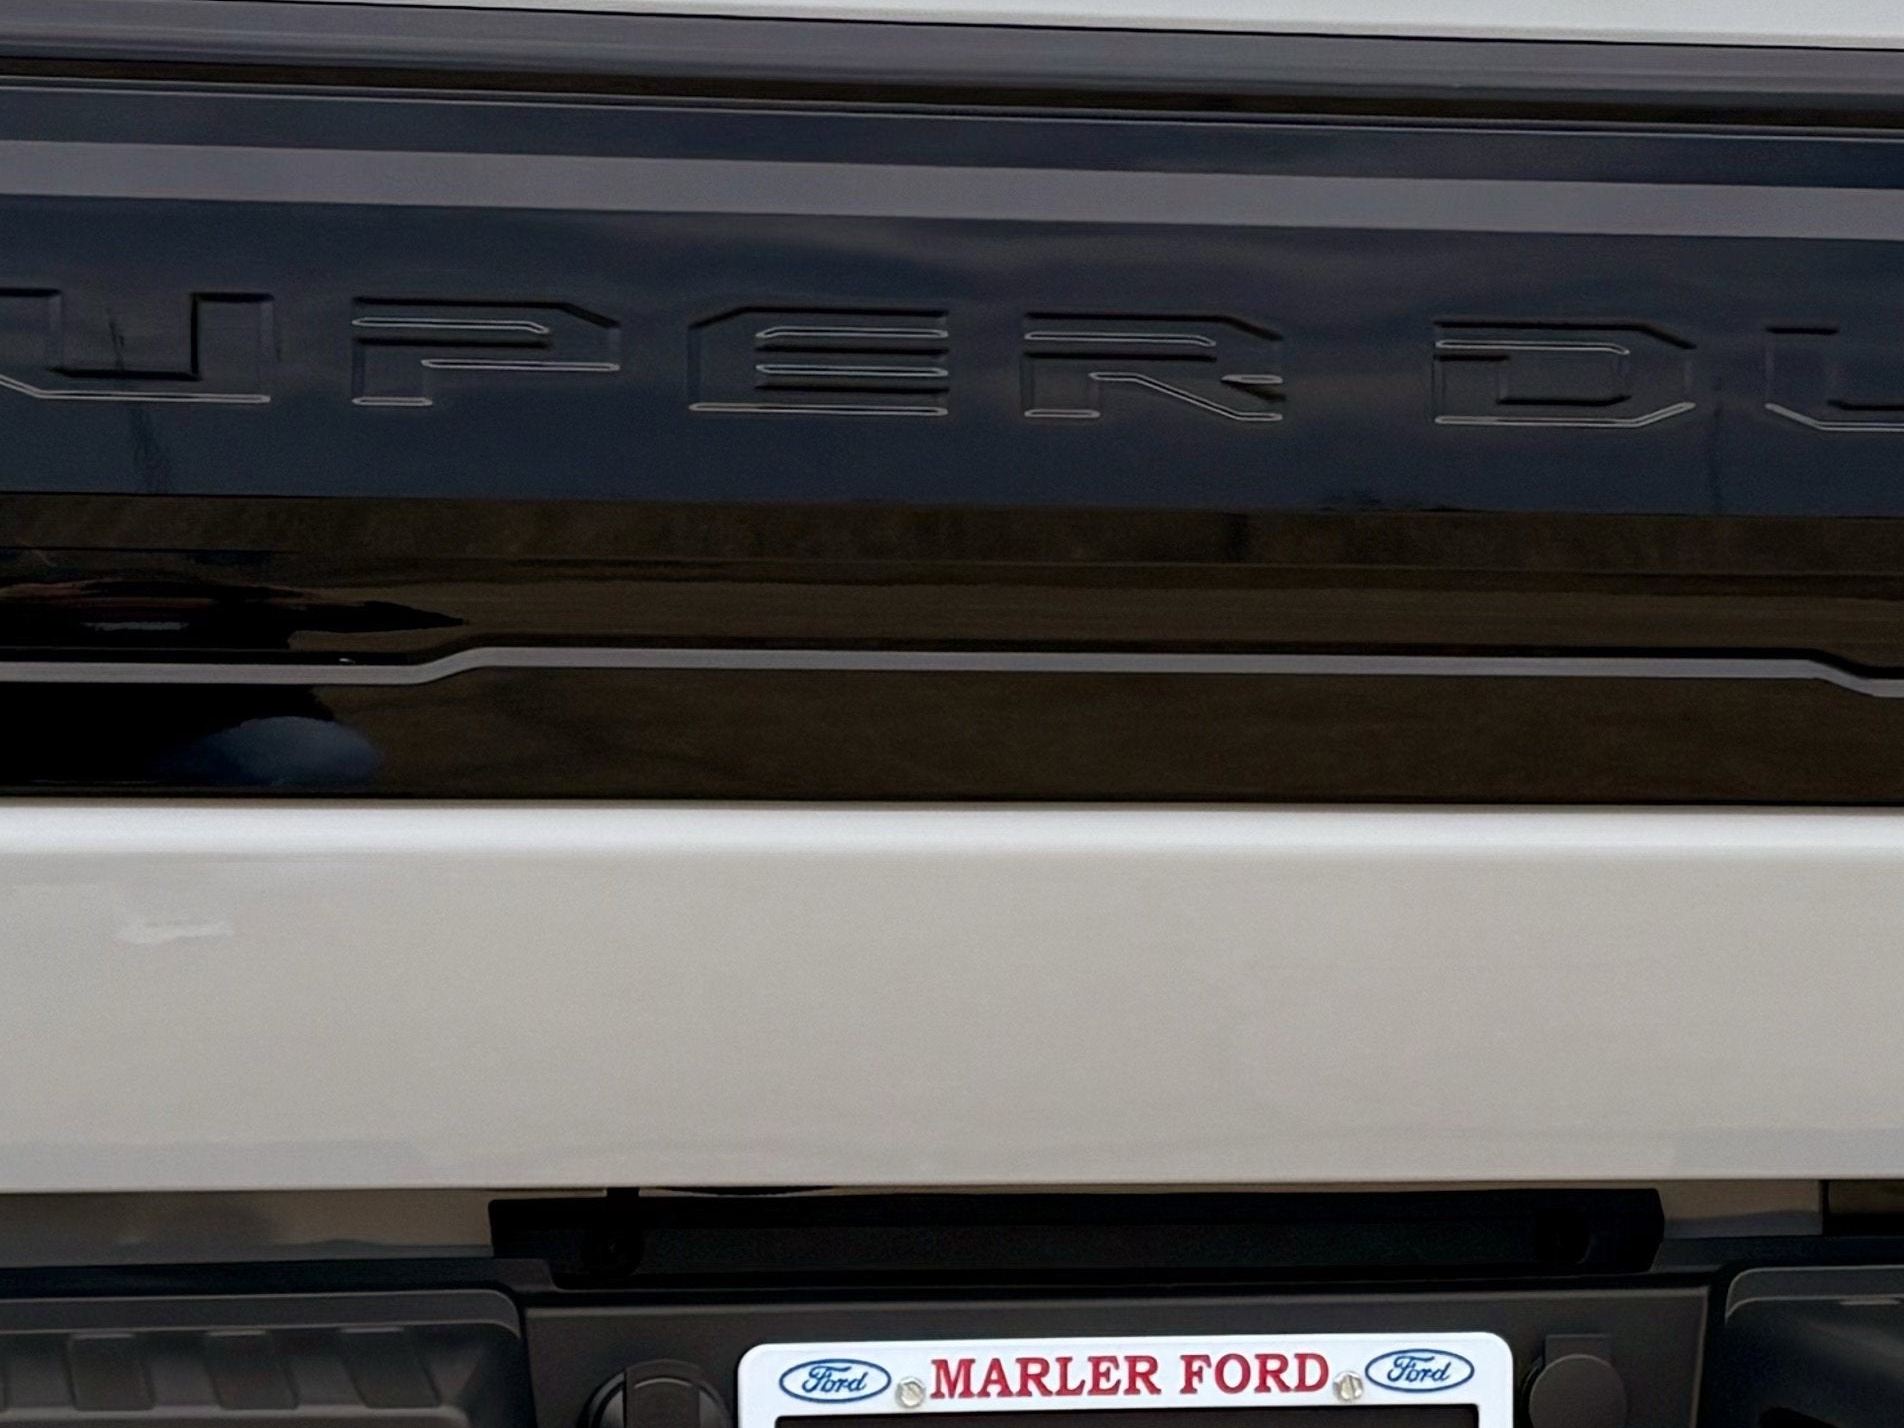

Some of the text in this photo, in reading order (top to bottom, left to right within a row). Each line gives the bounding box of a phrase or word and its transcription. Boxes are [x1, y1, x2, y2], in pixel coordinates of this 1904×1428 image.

[803, 1364, 868, 1394] Ford
[930, 1353, 1329, 1399] MARLER FORD
[1387, 1355, 1452, 1383] Ford
